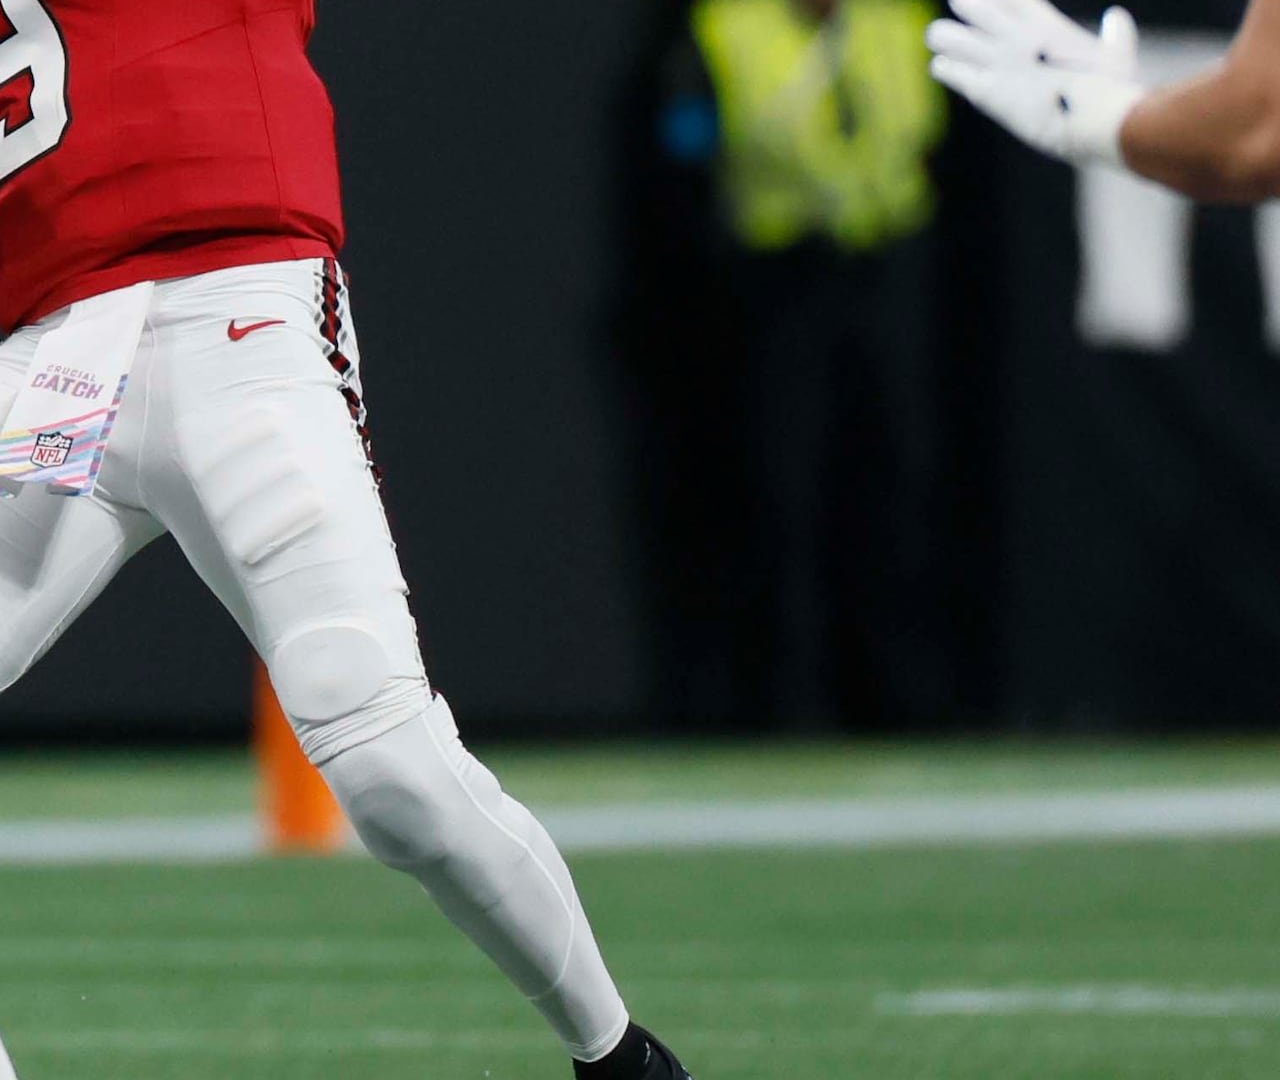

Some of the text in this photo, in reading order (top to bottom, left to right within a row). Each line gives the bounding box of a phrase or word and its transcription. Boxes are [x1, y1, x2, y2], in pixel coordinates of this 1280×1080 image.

[45, 364, 96, 382] CRUCIAL
[30, 373, 105, 400] CATCH
[34, 447, 63, 465] NFL
